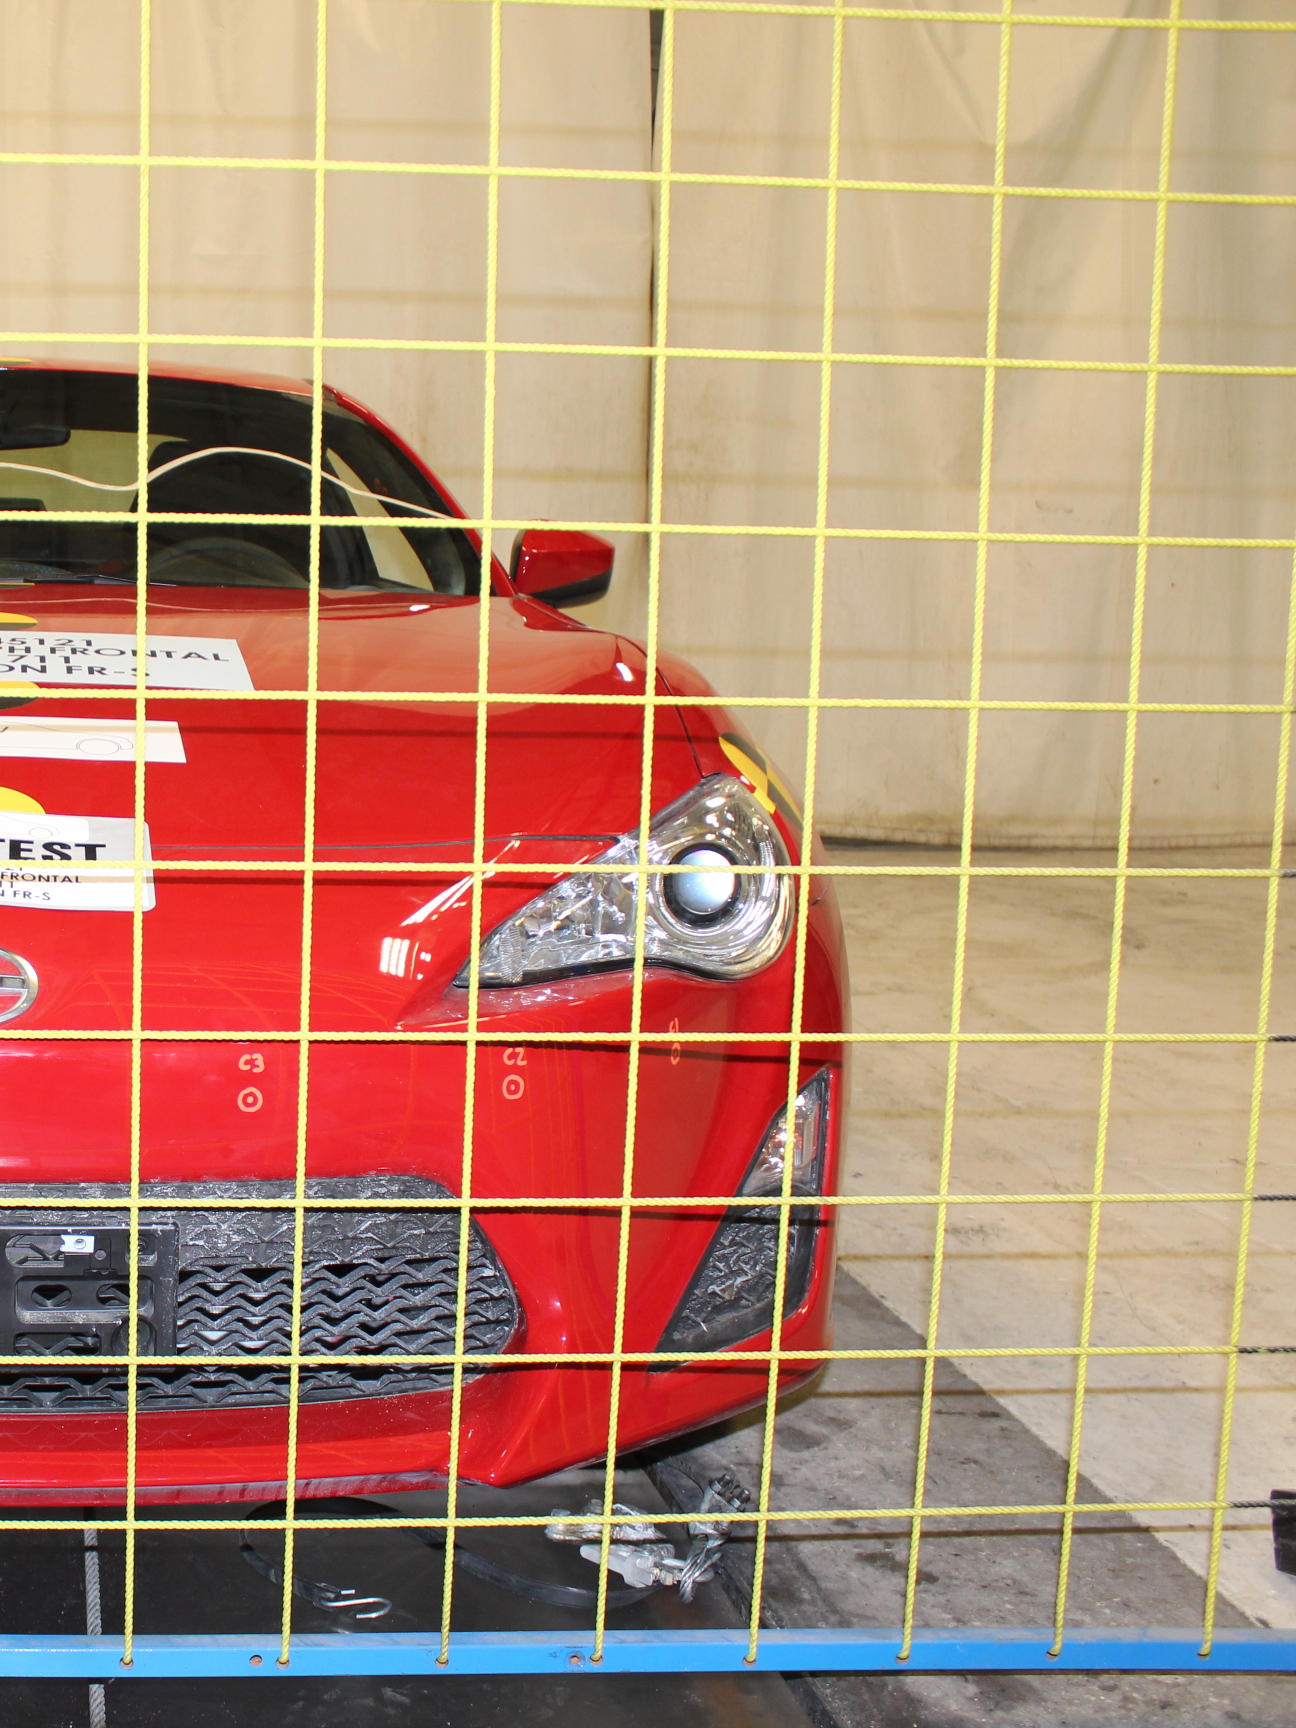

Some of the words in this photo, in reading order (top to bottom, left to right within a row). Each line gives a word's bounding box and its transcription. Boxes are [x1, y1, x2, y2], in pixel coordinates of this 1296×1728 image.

[49, 646, 230, 661] FRONTAL
[0, 871, 82, 884] FRONTAL
[12, 890, 51, 901] FR-S
[238, 1053, 265, 1073] C3
[503, 1047, 527, 1066] C2
